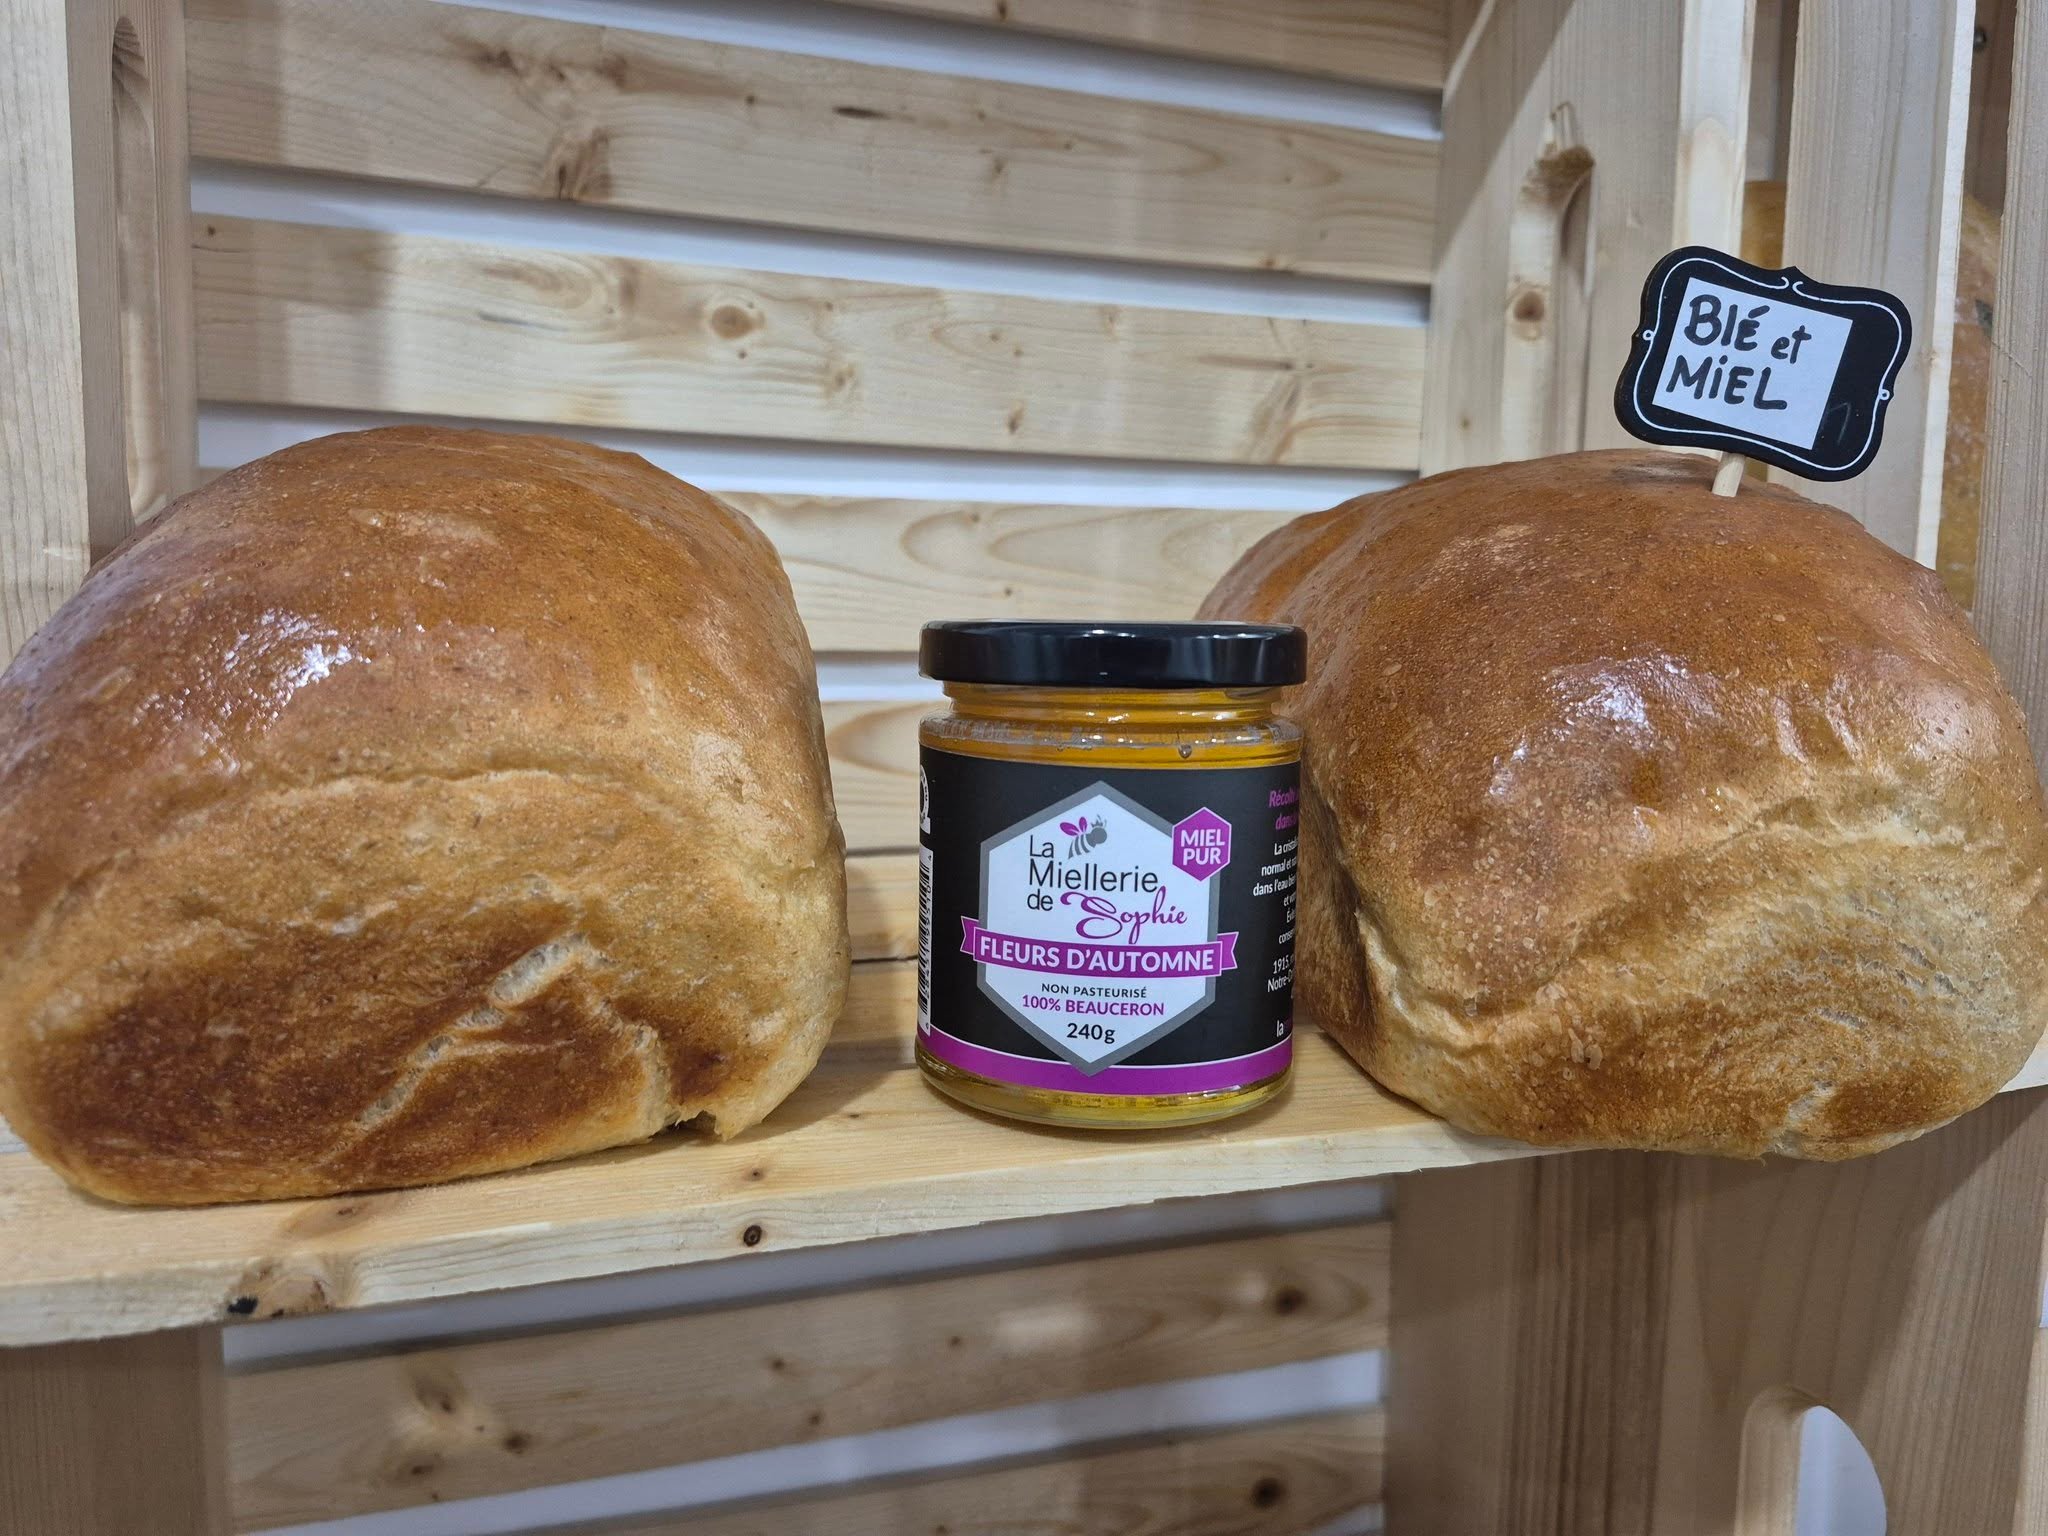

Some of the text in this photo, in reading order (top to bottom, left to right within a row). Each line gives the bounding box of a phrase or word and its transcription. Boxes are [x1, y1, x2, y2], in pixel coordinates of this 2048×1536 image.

[1771, 325, 1812, 364] et
[1029, 834, 1054, 858] La
[1180, 829, 1226, 848] MIEL
[1274, 842, 1282, 855] La
[1182, 847, 1222, 866] PUR
[1029, 858, 1158, 892] Miellerie
[1261, 859, 1286, 877] normal
[1253, 882, 1273, 896] dans
[1027, 885, 1187, 945] de Sophie
[980, 936, 1214, 973] FLEURS D'AUTOMNE
[1041, 983, 1147, 999] NON PASTEURISÉ
[1022, 994, 1165, 1016] 100% BEAUCERON
[1066, 1022, 1115, 1044] 240g
